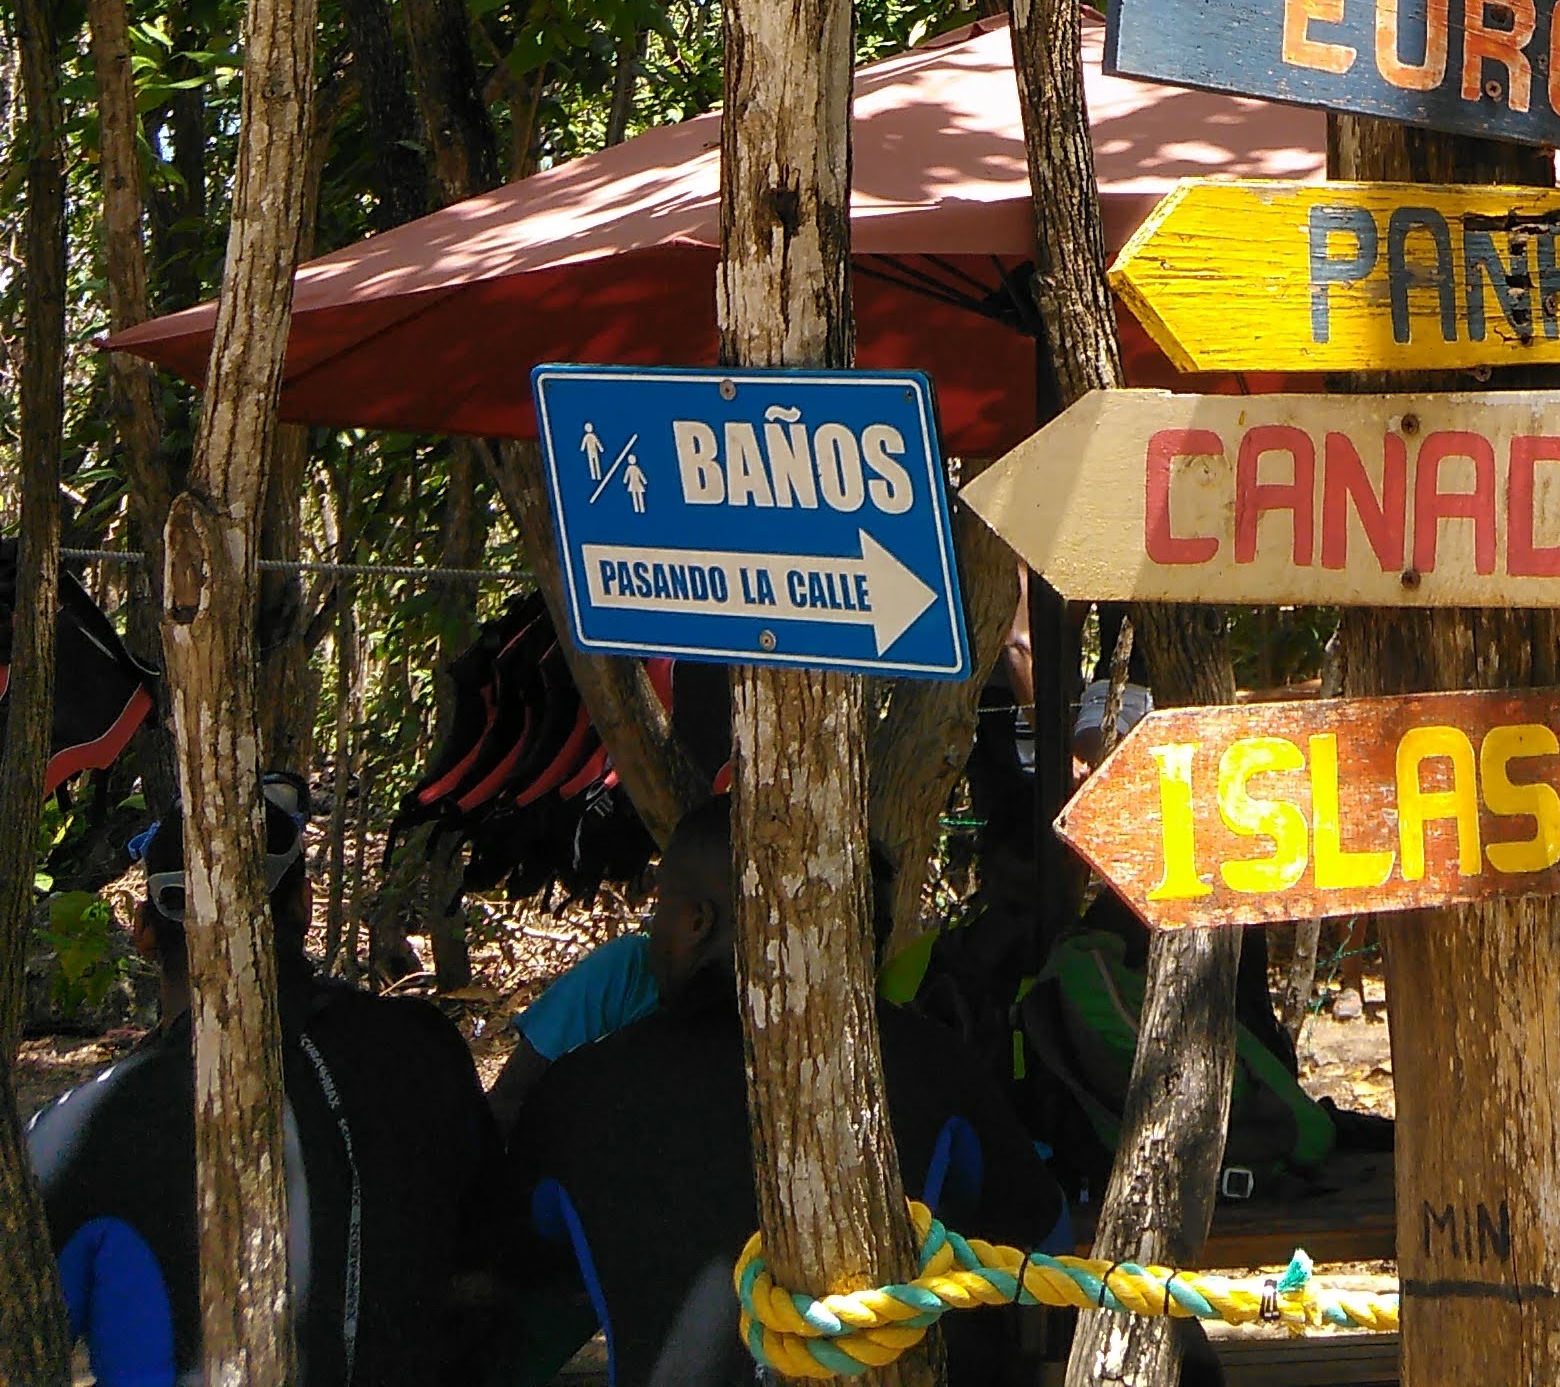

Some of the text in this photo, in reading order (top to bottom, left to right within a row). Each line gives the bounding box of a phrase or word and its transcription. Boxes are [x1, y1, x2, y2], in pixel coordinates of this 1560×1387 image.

[672, 405, 914, 515] BAÑOS
[599, 559, 872, 611] PASANDO LA CALLE
[1423, 1199, 1511, 1265] MIN
